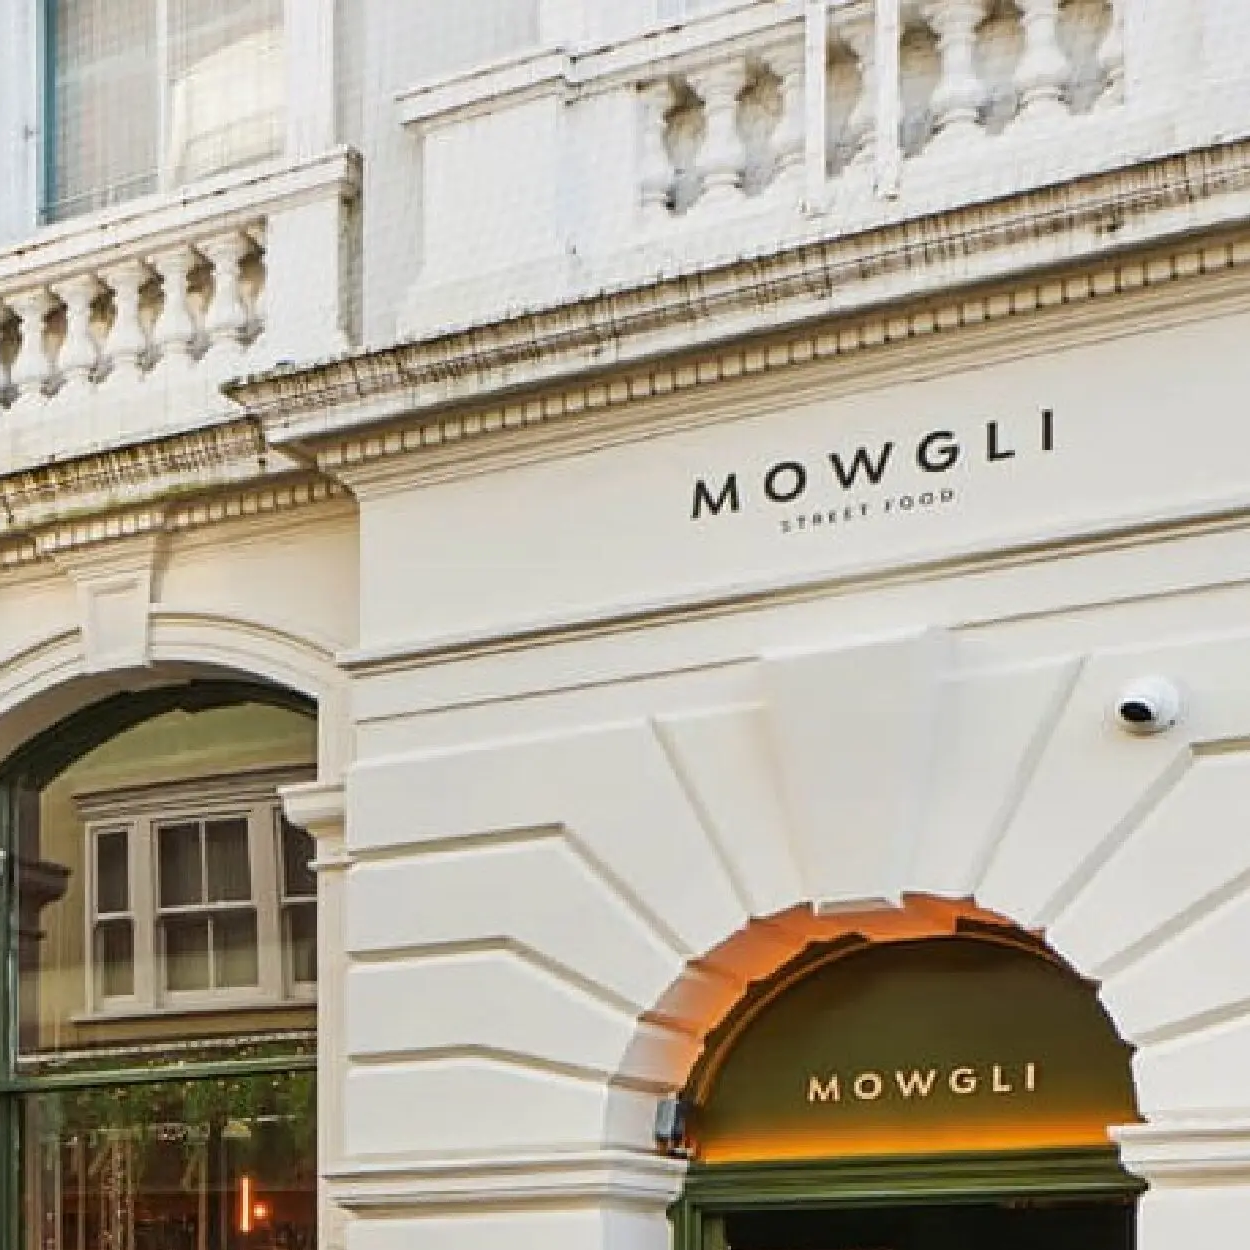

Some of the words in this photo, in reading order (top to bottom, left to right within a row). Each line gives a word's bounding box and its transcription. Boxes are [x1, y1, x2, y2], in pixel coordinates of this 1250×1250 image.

[690, 408, 1054, 520] MOWGLI
[884, 488, 955, 512] FOOD
[807, 1062, 1036, 1102] MOWGLI
